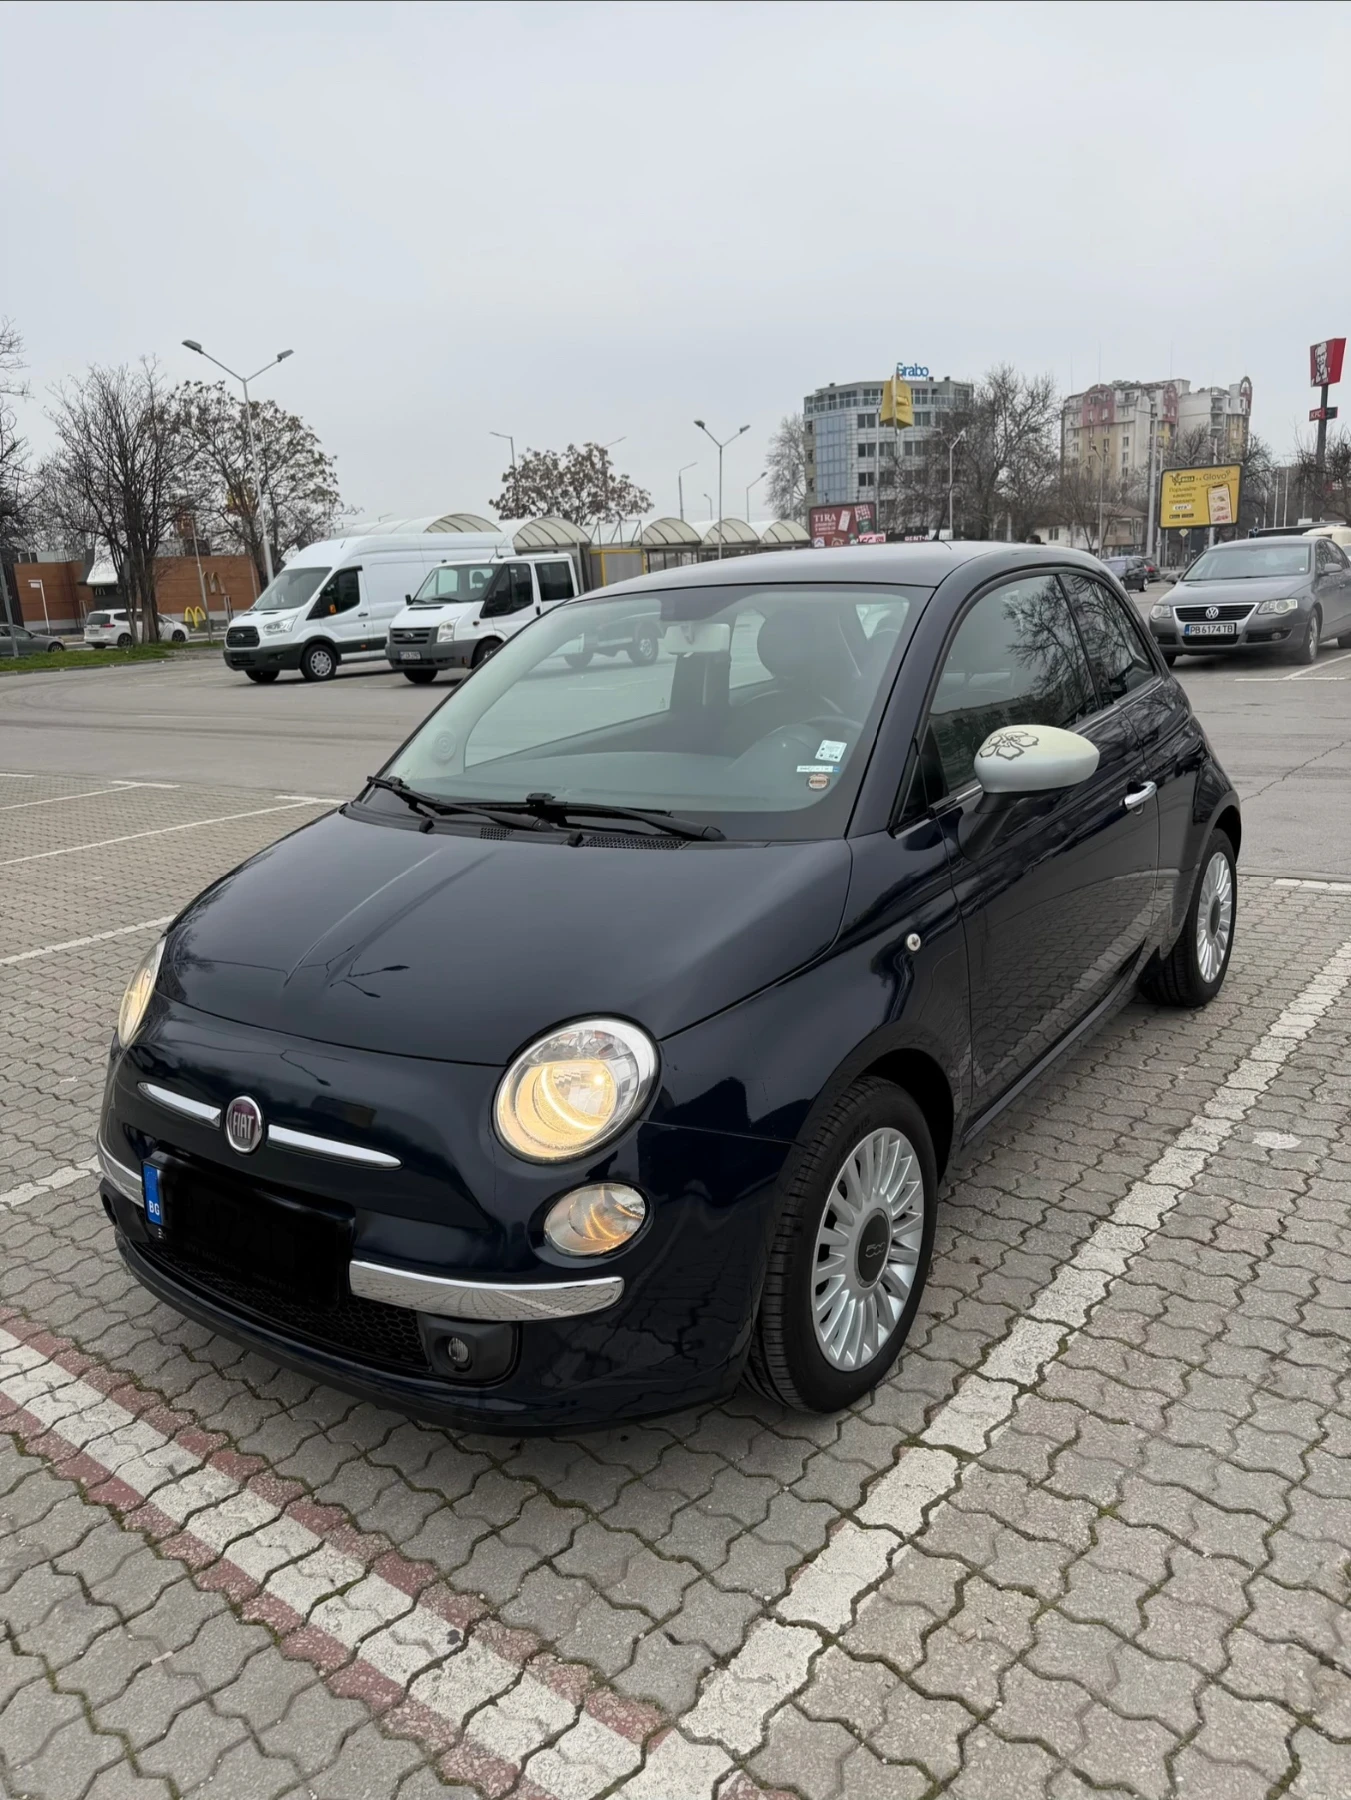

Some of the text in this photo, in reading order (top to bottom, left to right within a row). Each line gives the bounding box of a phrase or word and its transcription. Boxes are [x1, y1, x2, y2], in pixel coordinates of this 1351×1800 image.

[897, 362, 929, 377] Grabo
[1203, 473, 1227, 481] Glovo
[813, 513, 836, 522] TIRA
[1190, 625, 1233, 634] PB 6174 TB
[232, 1111, 255, 1139] FIAT
[148, 1200, 160, 1216] BG
